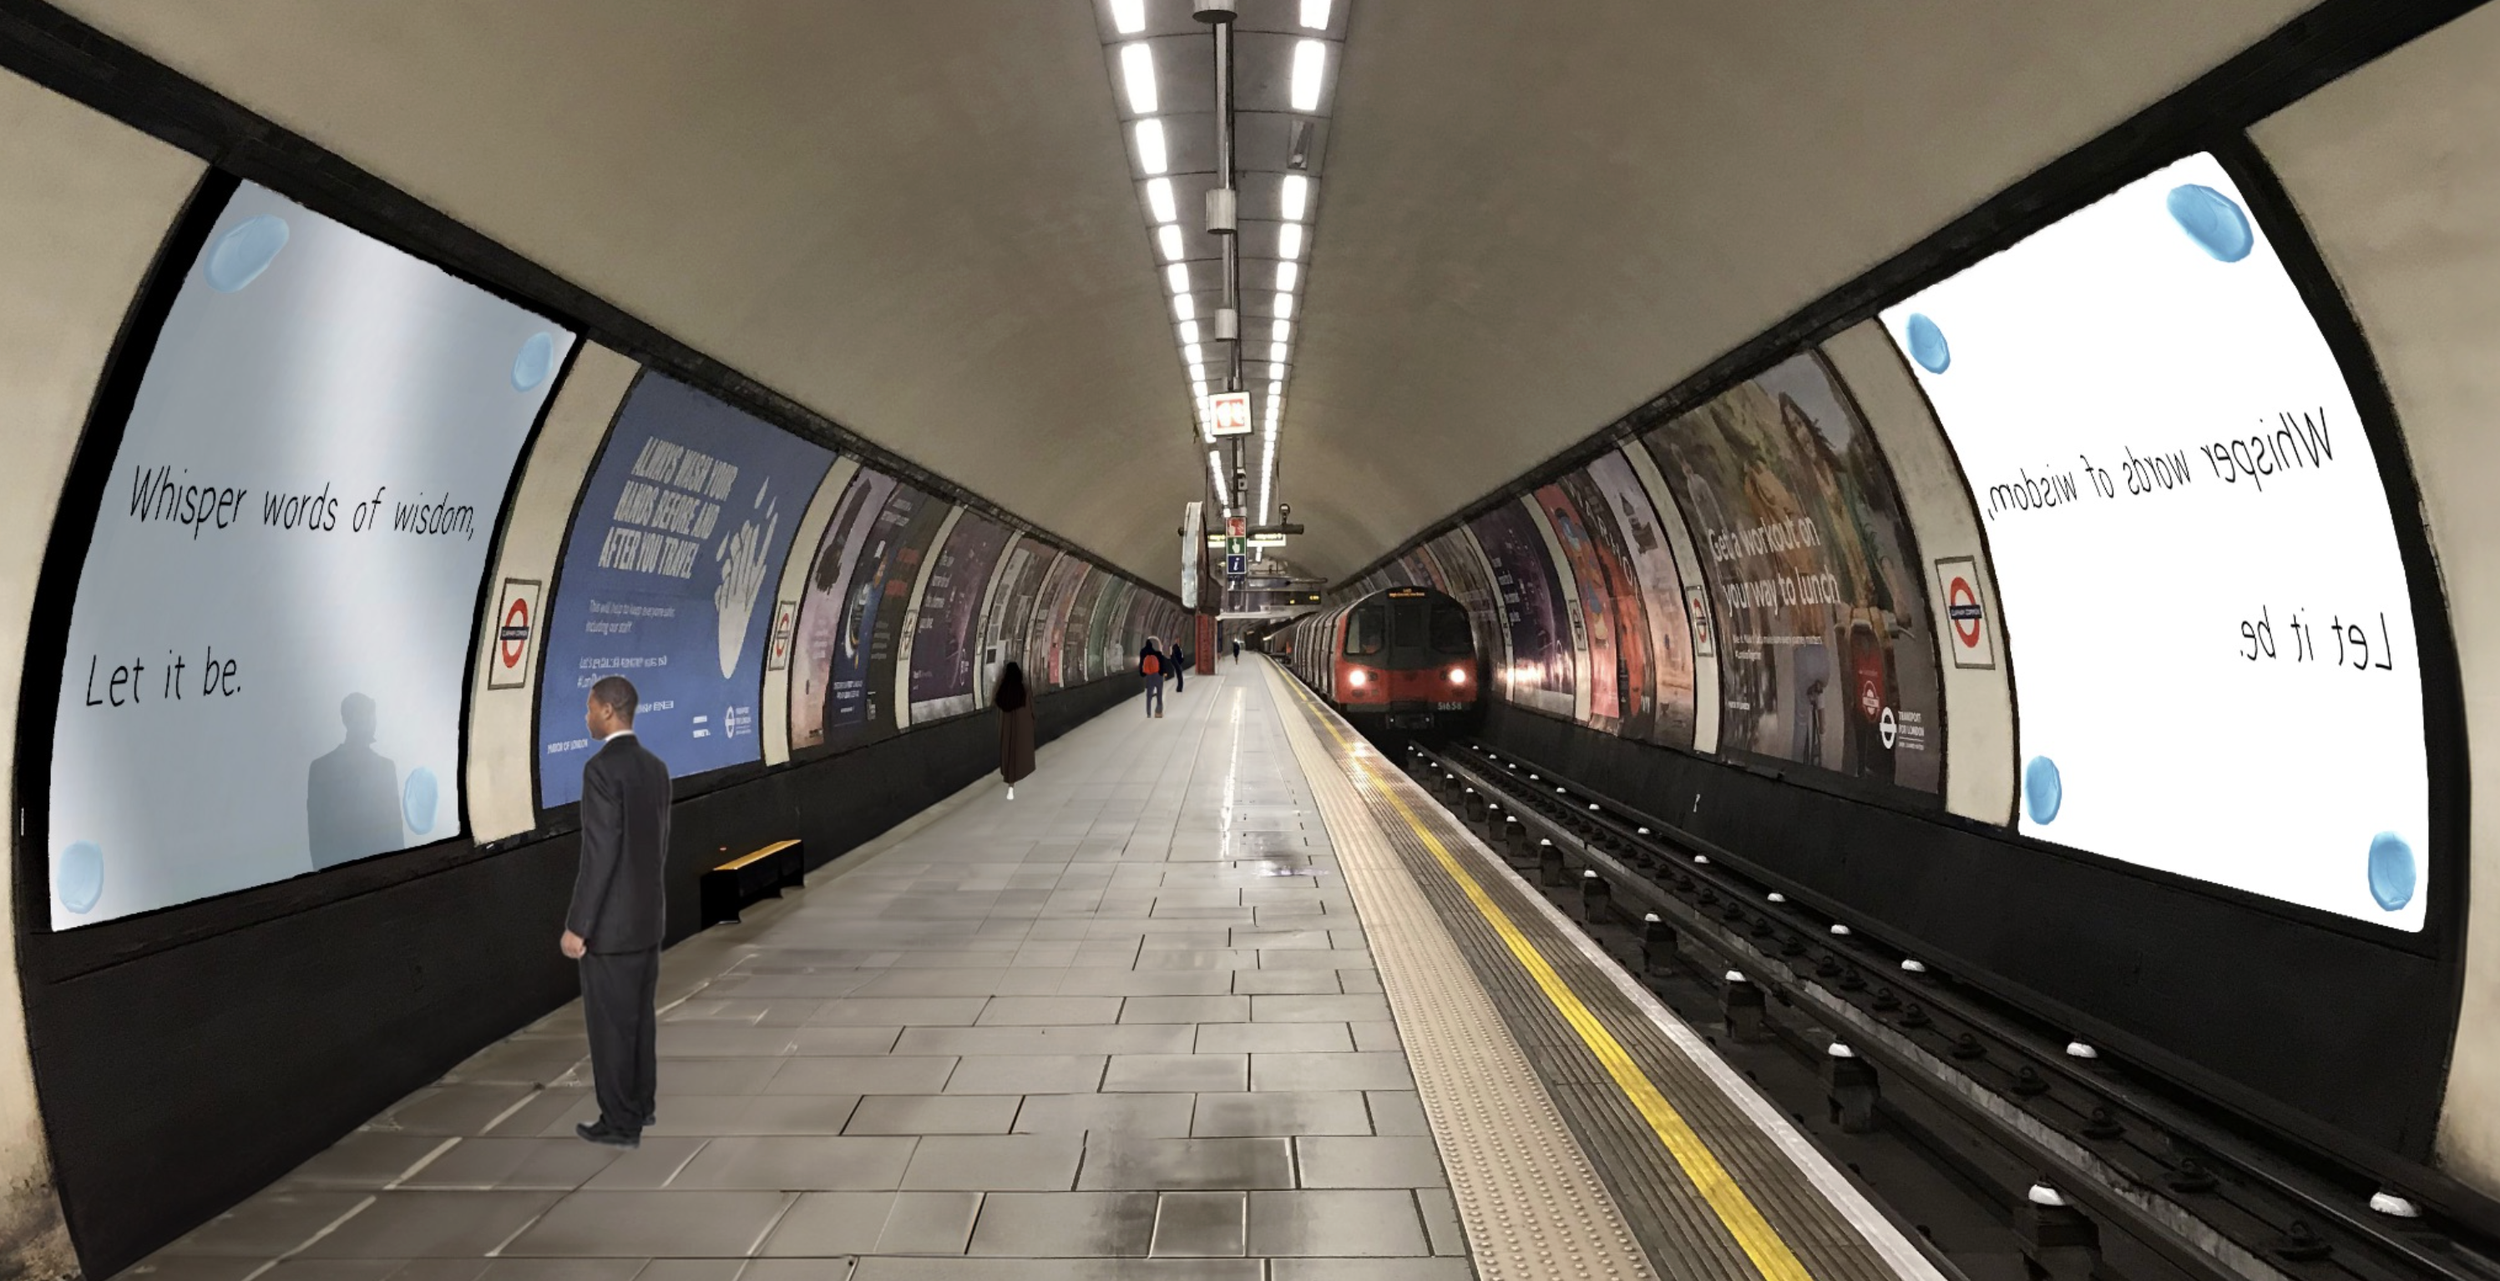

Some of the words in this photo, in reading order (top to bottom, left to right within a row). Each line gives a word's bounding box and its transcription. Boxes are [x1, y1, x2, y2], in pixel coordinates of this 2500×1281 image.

[631, 436, 684, 484] ALWAYS
[673, 449, 714, 493] WASH
[704, 459, 738, 502] YOUR
[130, 464, 248, 541] Whisper
[263, 482, 338, 532] words
[352, 486, 386, 533] of
[394, 492, 475, 541] wisdom,
[613, 480, 659, 527] HANDS
[651, 489, 701, 535] BEFORE
[690, 501, 721, 540] AND
[598, 526, 642, 571] AFTER
[636, 531, 665, 573] YOU
[657, 536, 700, 580] TRAVEL
[1708, 528, 1731, 562] Get
[1731, 531, 1743, 557] a
[1742, 515, 1801, 556] workout
[1798, 515, 1821, 547] on
[1722, 582, 1751, 617] your
[1750, 577, 1780, 616] way
[1777, 572, 1796, 606] to
[1795, 564, 1840, 604] lunch
[85, 654, 145, 708] Let
[164, 649, 186, 701] it
[202, 646, 242, 697] be.
